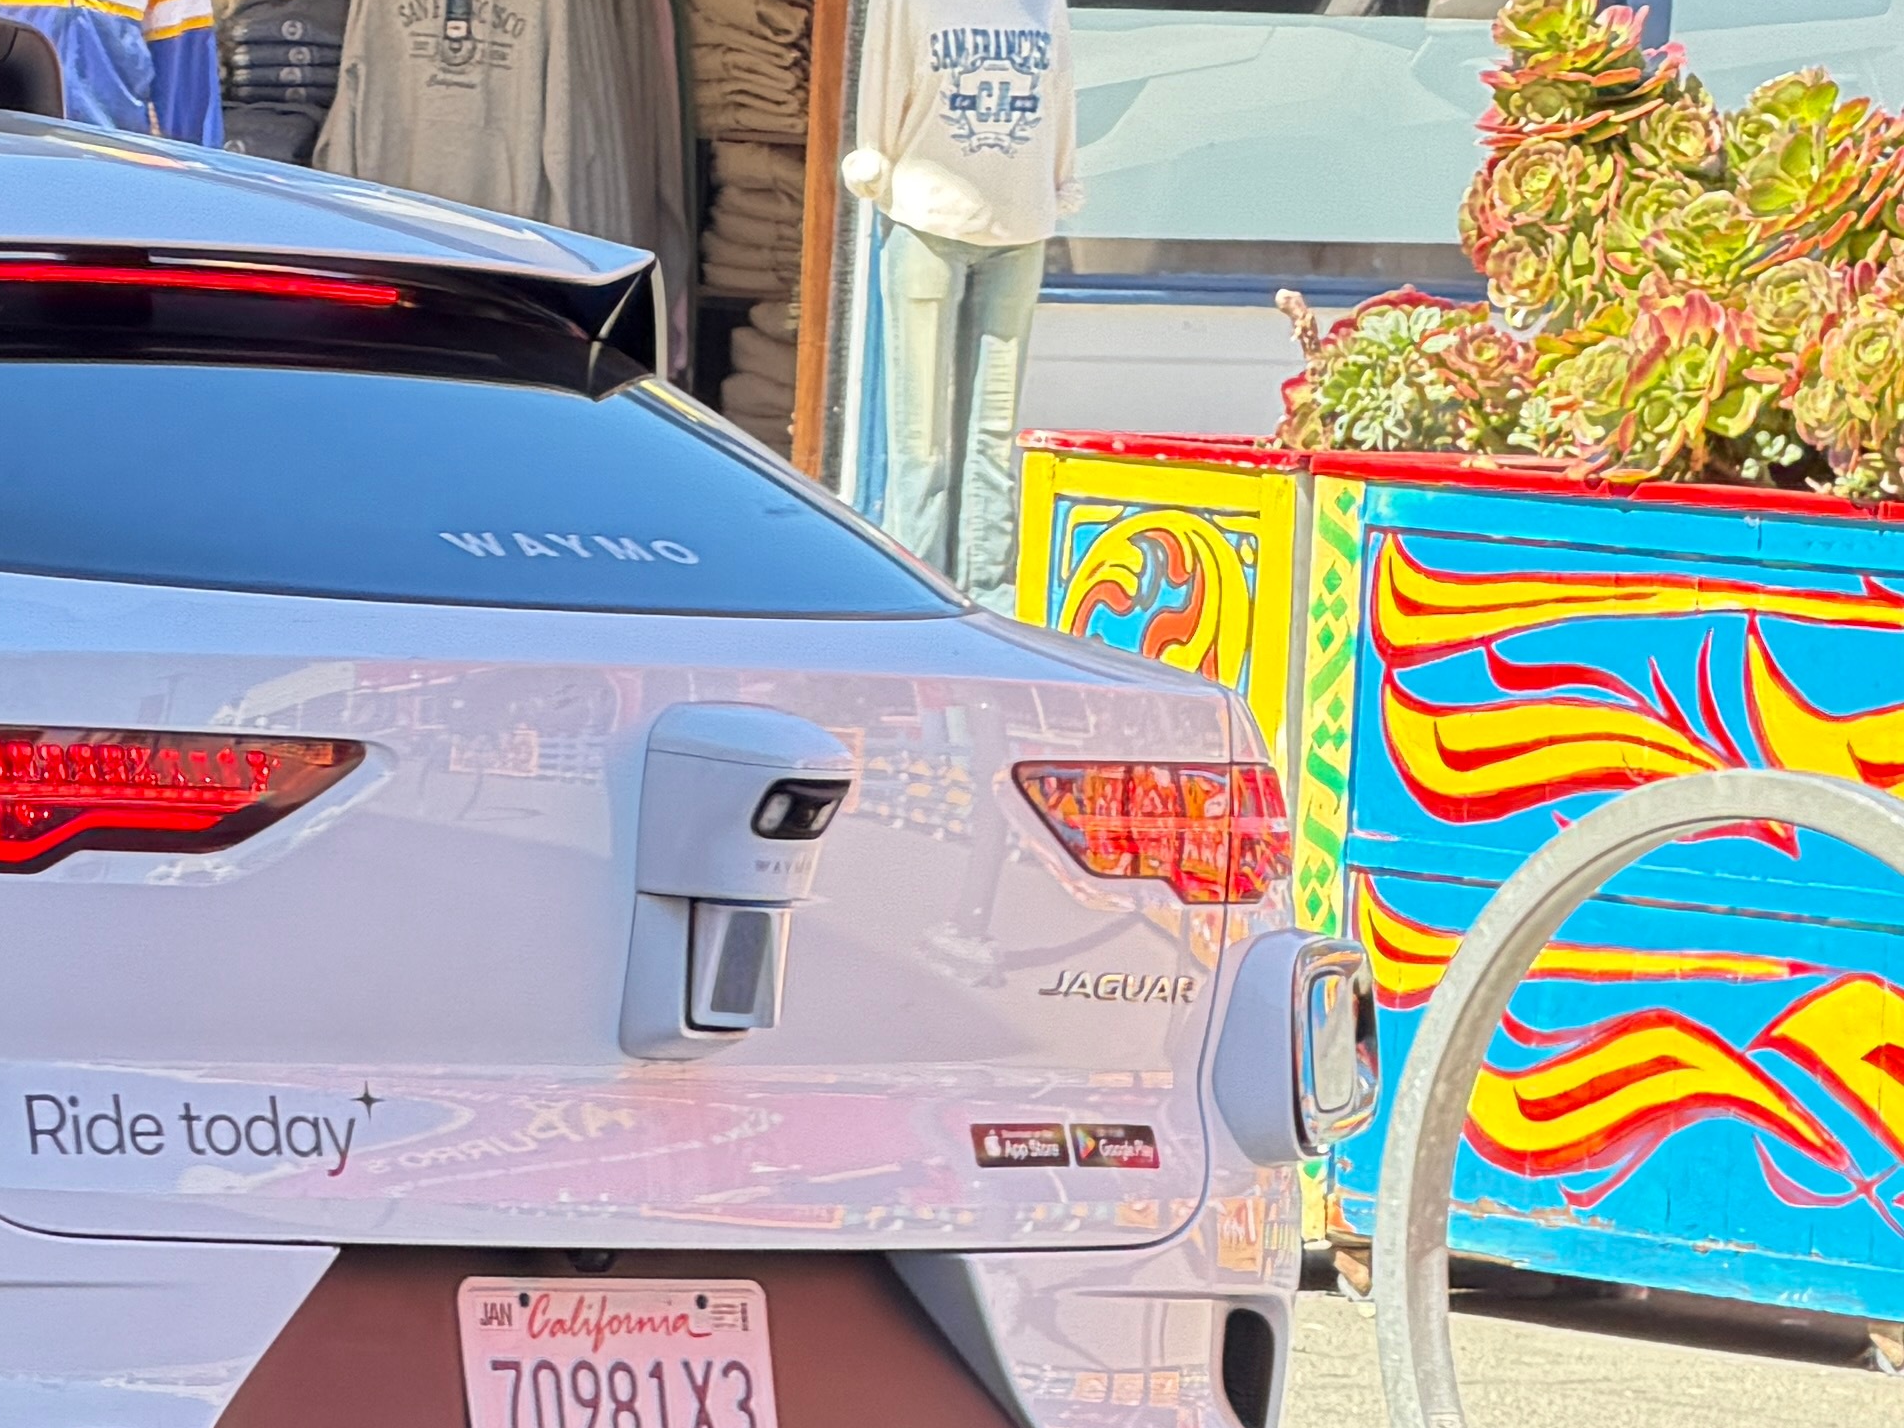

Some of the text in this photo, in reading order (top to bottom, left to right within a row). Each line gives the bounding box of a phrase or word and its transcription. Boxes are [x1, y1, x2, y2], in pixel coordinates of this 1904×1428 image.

[975, 80, 1013, 123] CA
[438, 531, 700, 565] WAYMO
[1038, 969, 1199, 1005] JAGUAR
[24, 1093, 356, 1178] Ride today
[1004, 1138, 1061, 1161] App Store
[1098, 1138, 1154, 1162] Google Play
[479, 1302, 514, 1327] JAN
[527, 1292, 713, 1353] California
